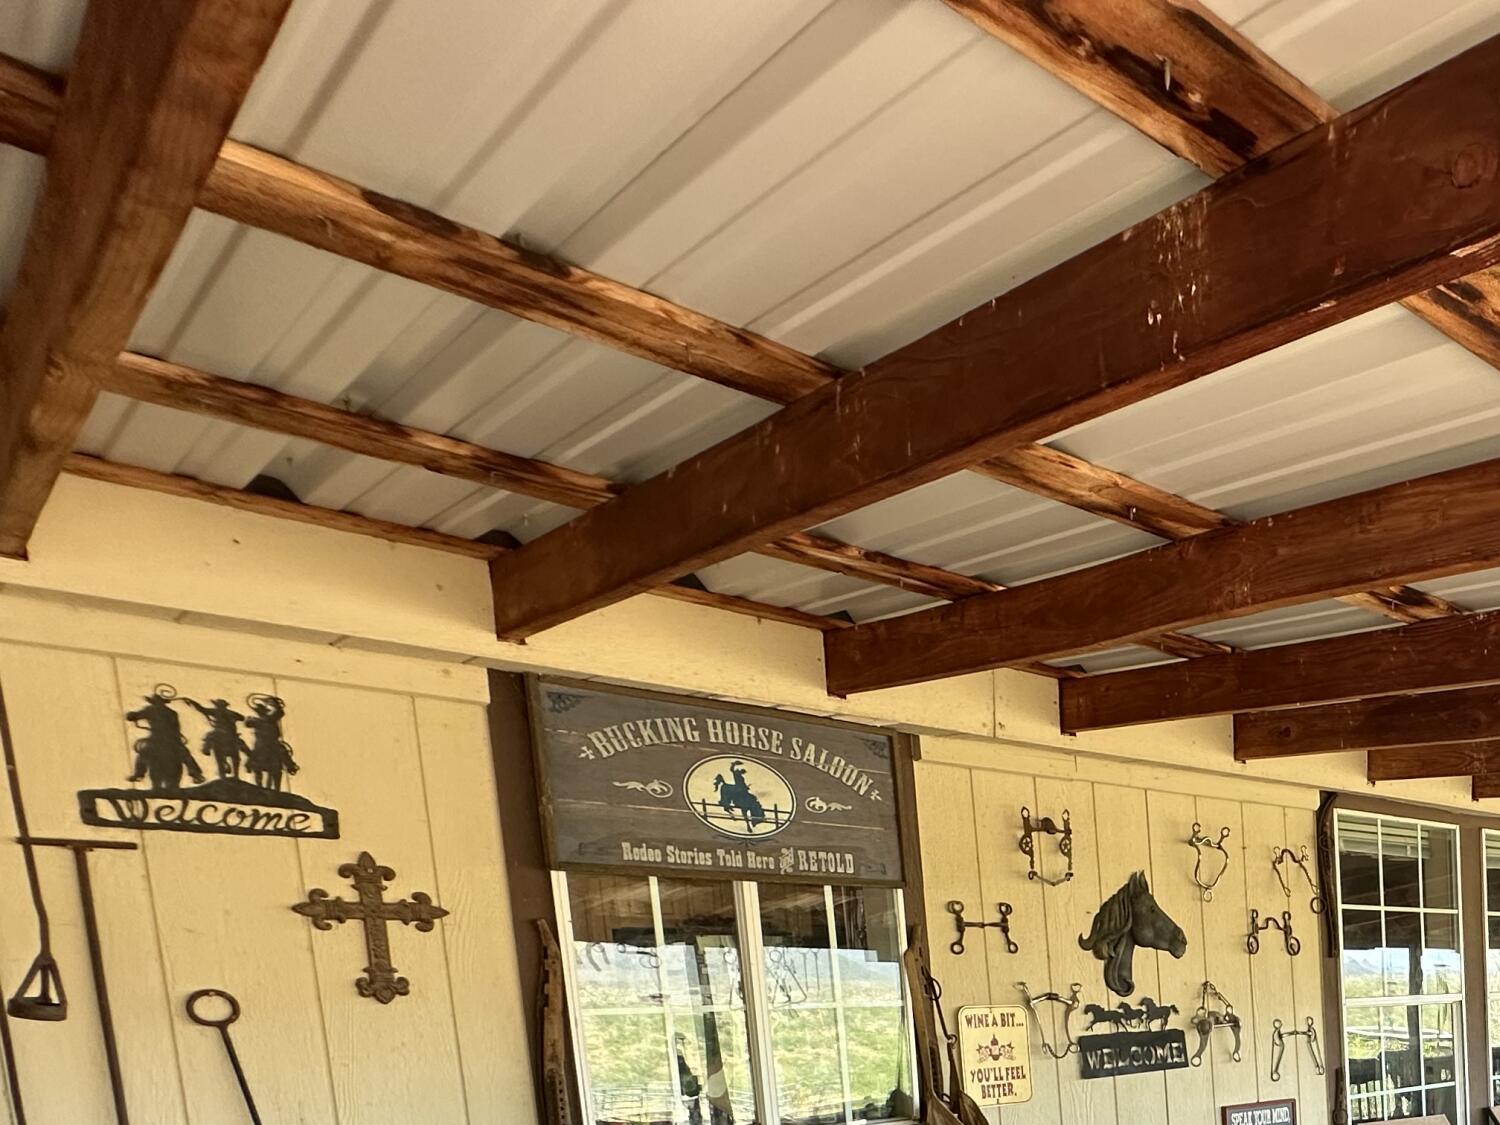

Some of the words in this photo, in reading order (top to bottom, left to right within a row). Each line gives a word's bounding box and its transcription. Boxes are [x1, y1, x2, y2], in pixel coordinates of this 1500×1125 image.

[587, 717, 700, 759] BUCKING
[706, 718, 784, 755] HORSE
[790, 737, 874, 796] SALOON
[108, 797, 311, 832] Welcome
[621, 842, 662, 862] Rodeo
[666, 845, 713, 866] Stories
[716, 848, 743, 868] Told
[746, 850, 775, 870] Here
[797, 850, 855, 874] RETOLD
[965, 1013, 990, 1029] WINE
[991, 1013, 999, 1028] A
[1000, 1012, 1024, 1028] BIT...
[1086, 1041, 1186, 1070] WELCOME
[970, 1066, 1004, 1084] YOU'LL
[1005, 1065, 1027, 1082] FEEL
[980, 1082, 1018, 1100] BETTER.
[1272, 1106, 1291, 1124] MIND,
